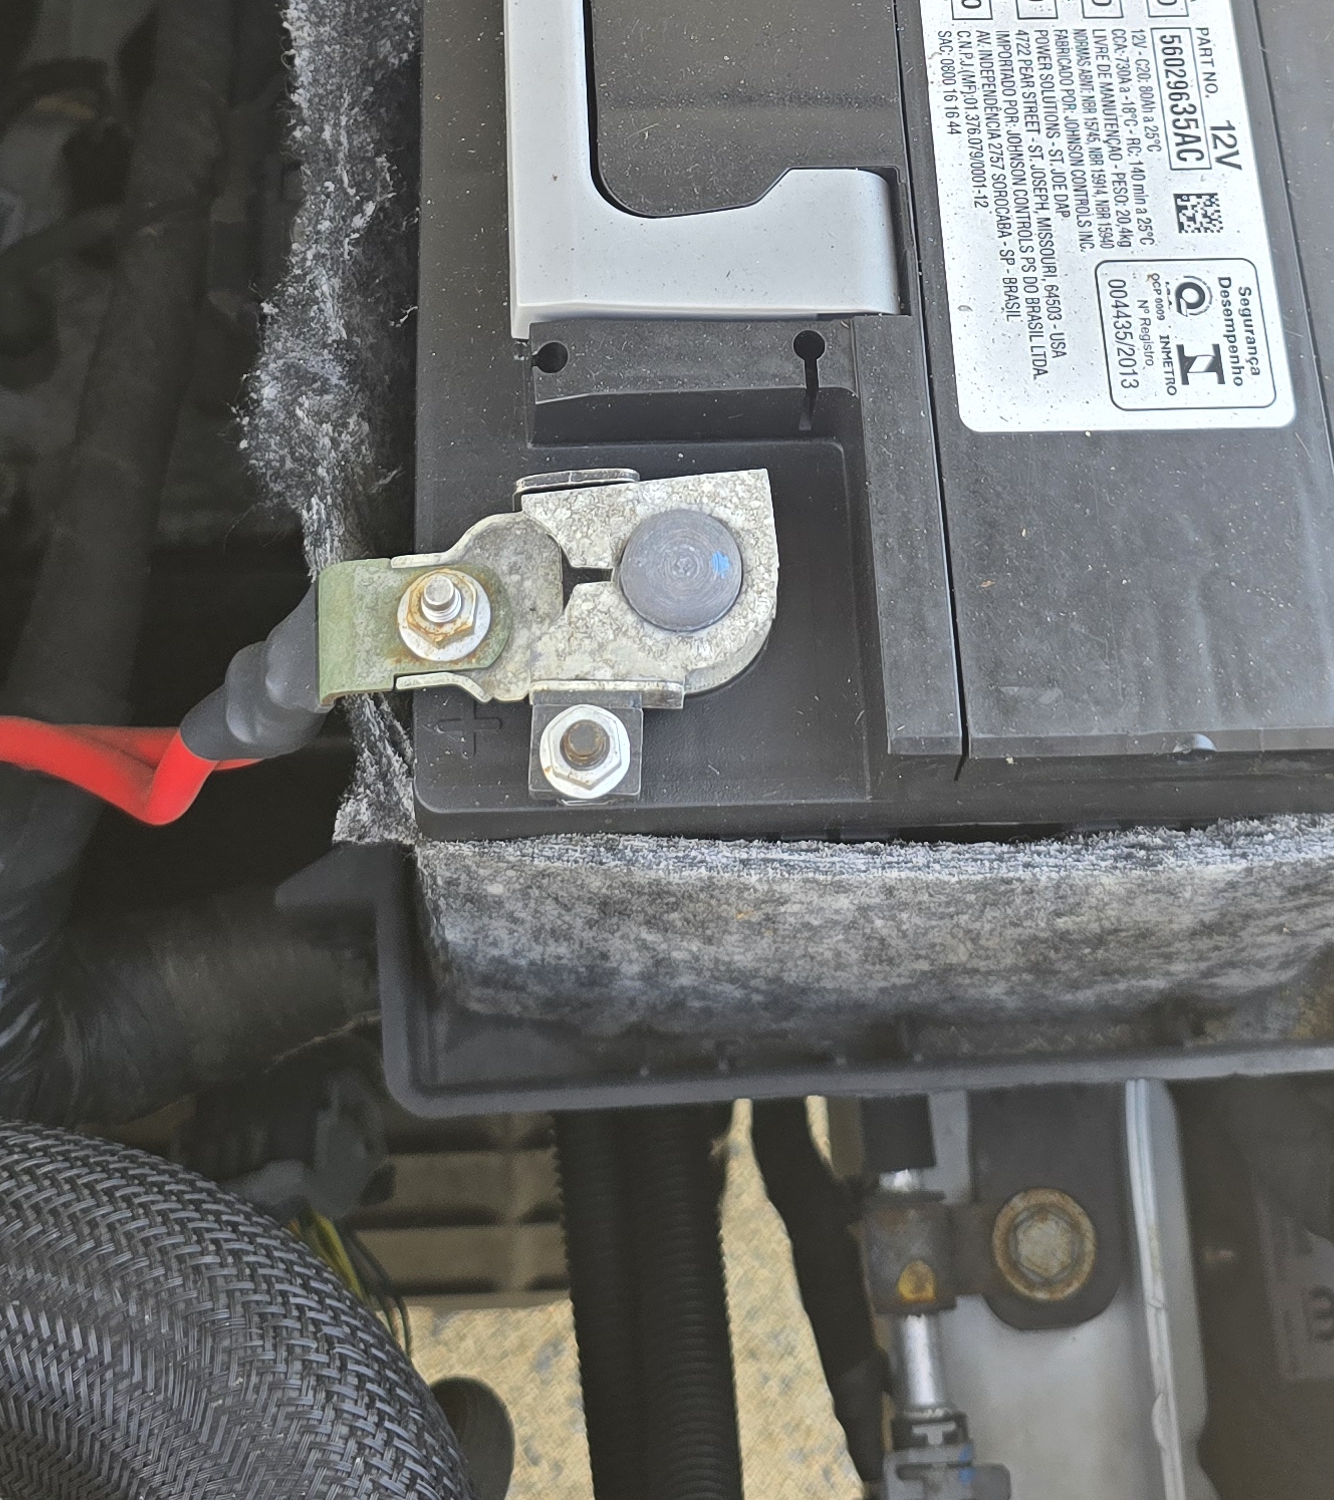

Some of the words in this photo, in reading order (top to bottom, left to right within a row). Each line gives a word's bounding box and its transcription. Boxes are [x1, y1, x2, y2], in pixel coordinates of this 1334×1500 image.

[975, 29, 992, 47] AV.
[1013, 29, 1032, 56] 4722
[1033, 29, 1053, 70] POWER
[1194, 27, 1215, 67] PART
[939, 58, 957, 85] 0800
[994, 30, 1017, 97] IMPORTADO
[1016, 58, 1035, 88] PEAR
[1052, 29, 1074, 86] FABRICADO
[942, 88, 958, 102] 16
[977, 49, 1003, 140] INDEPENDÊNCIA
[1059, 88, 1078, 113] POR:
[1158, 34, 1205, 162] 56029635AC
[1201, 71, 1219, 98] NO.
[943, 105, 960, 119] 16
[1000, 99, 1020, 127] POR:
[1020, 91, 1041, 135] STREET
[1038, 73, 1061, 139] SOLUTIONS
[945, 120, 962, 135] 44
[1062, 115, 1084, 166] JOHNSON
[1208, 119, 1242, 171] 12V
[987, 142, 1005, 170] 2757
[1003, 129, 1027, 186] JOHNSON
[1026, 144, 1044, 161] ST.
[1047, 148, 1065, 166] ST.
[1027, 163, 1050, 214] JOSEPH,
[1049, 168, 1068, 191] JOE
[1069, 168, 1092, 228] CONTROLS
[990, 172, 1013, 238] SOROCABA
[1011, 188, 1035, 253] CONTROLS
[1052, 193, 1071, 218] DAP
[998, 249, 1016, 266] SP
[1032, 217, 1058, 281] MISSOURI,
[1077, 230, 1095, 252] INC.
[1019, 256, 1037, 272] PS
[999, 277, 1022, 321] BRASIL
[1021, 276, 1039, 293] DO
[1041, 284, 1063, 321] 64503
[1024, 297, 1045, 342] BRASIL
[1136, 299, 1150, 314] Nº
[1153, 297, 1166, 320] 0009
[1048, 331, 1067, 358] USA
[1106, 278, 1141, 389] 004435/2013
[1136, 317, 1157, 366] Registro
[1214, 276, 1247, 387] Desempenho
[1233, 286, 1264, 376] Segurança
[1029, 345, 1049, 380] LTDA.
[1158, 334, 1178, 396] INMETRO
